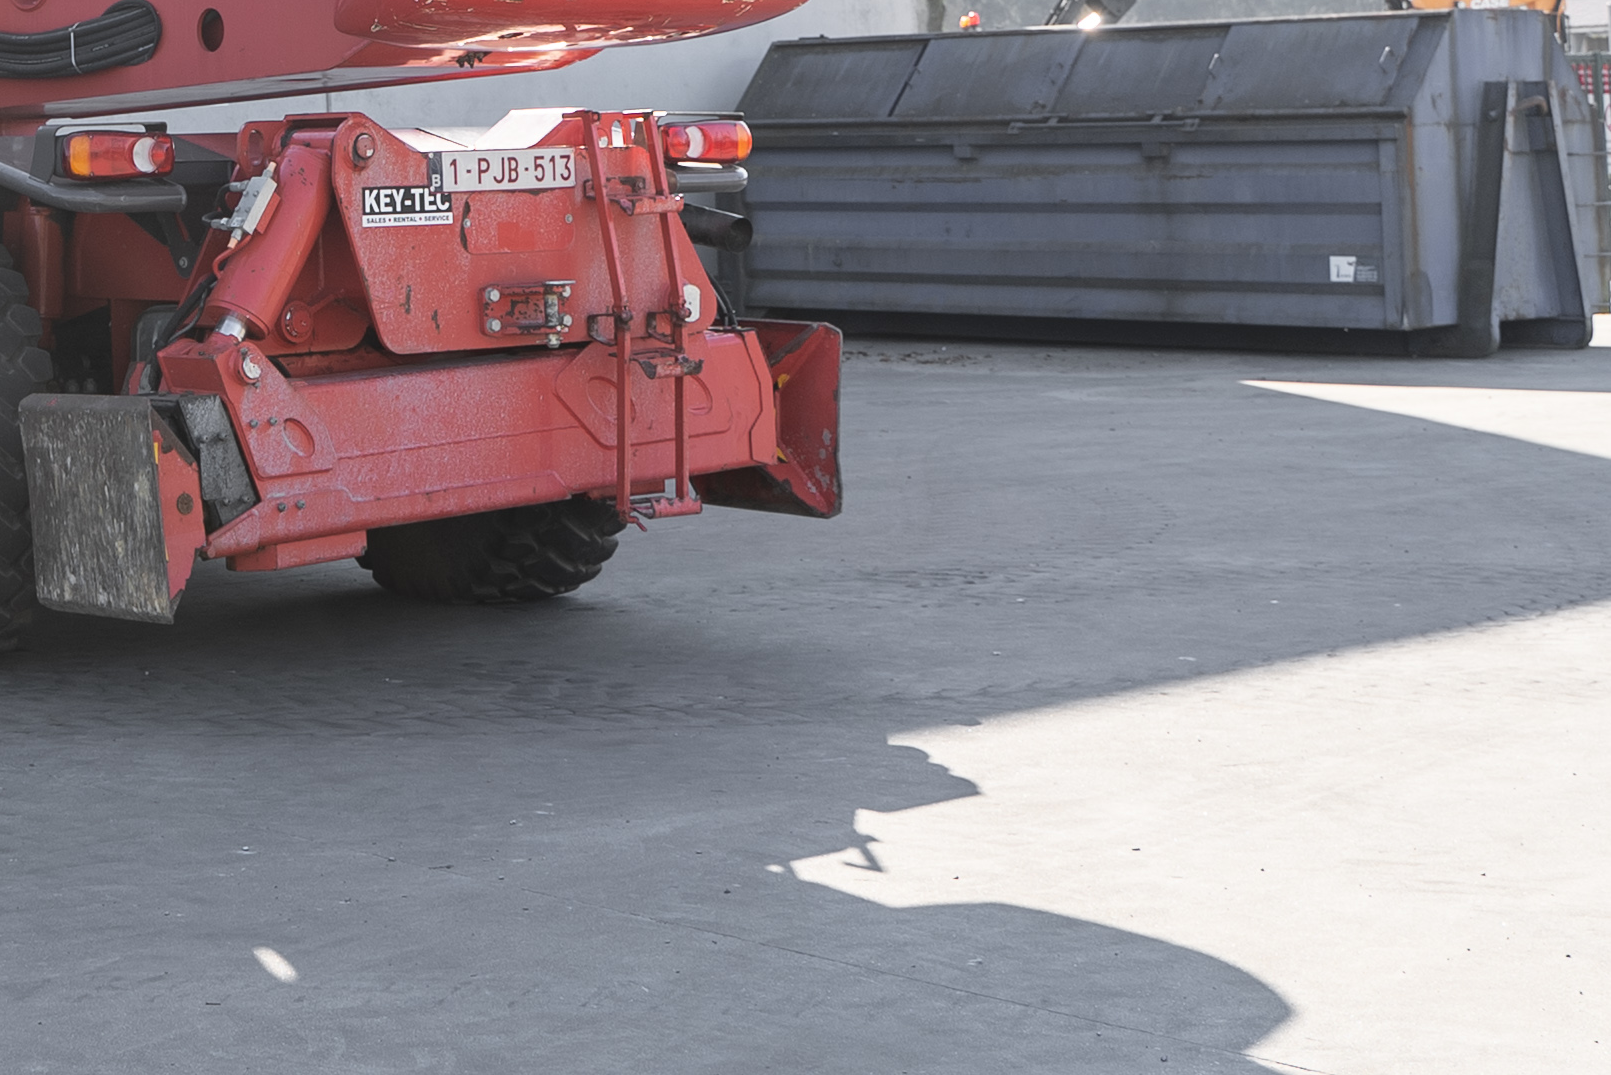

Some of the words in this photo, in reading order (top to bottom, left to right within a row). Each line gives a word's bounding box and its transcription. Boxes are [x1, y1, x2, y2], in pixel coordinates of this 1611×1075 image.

[431, 173, 442, 188] B
[449, 153, 572, 186] 1-PJB-513
[364, 186, 450, 214] KEY-TEC
[366, 216, 386, 224] SALES
[393, 215, 418, 223] RENTAL
[424, 214, 450, 222] SERVICE
